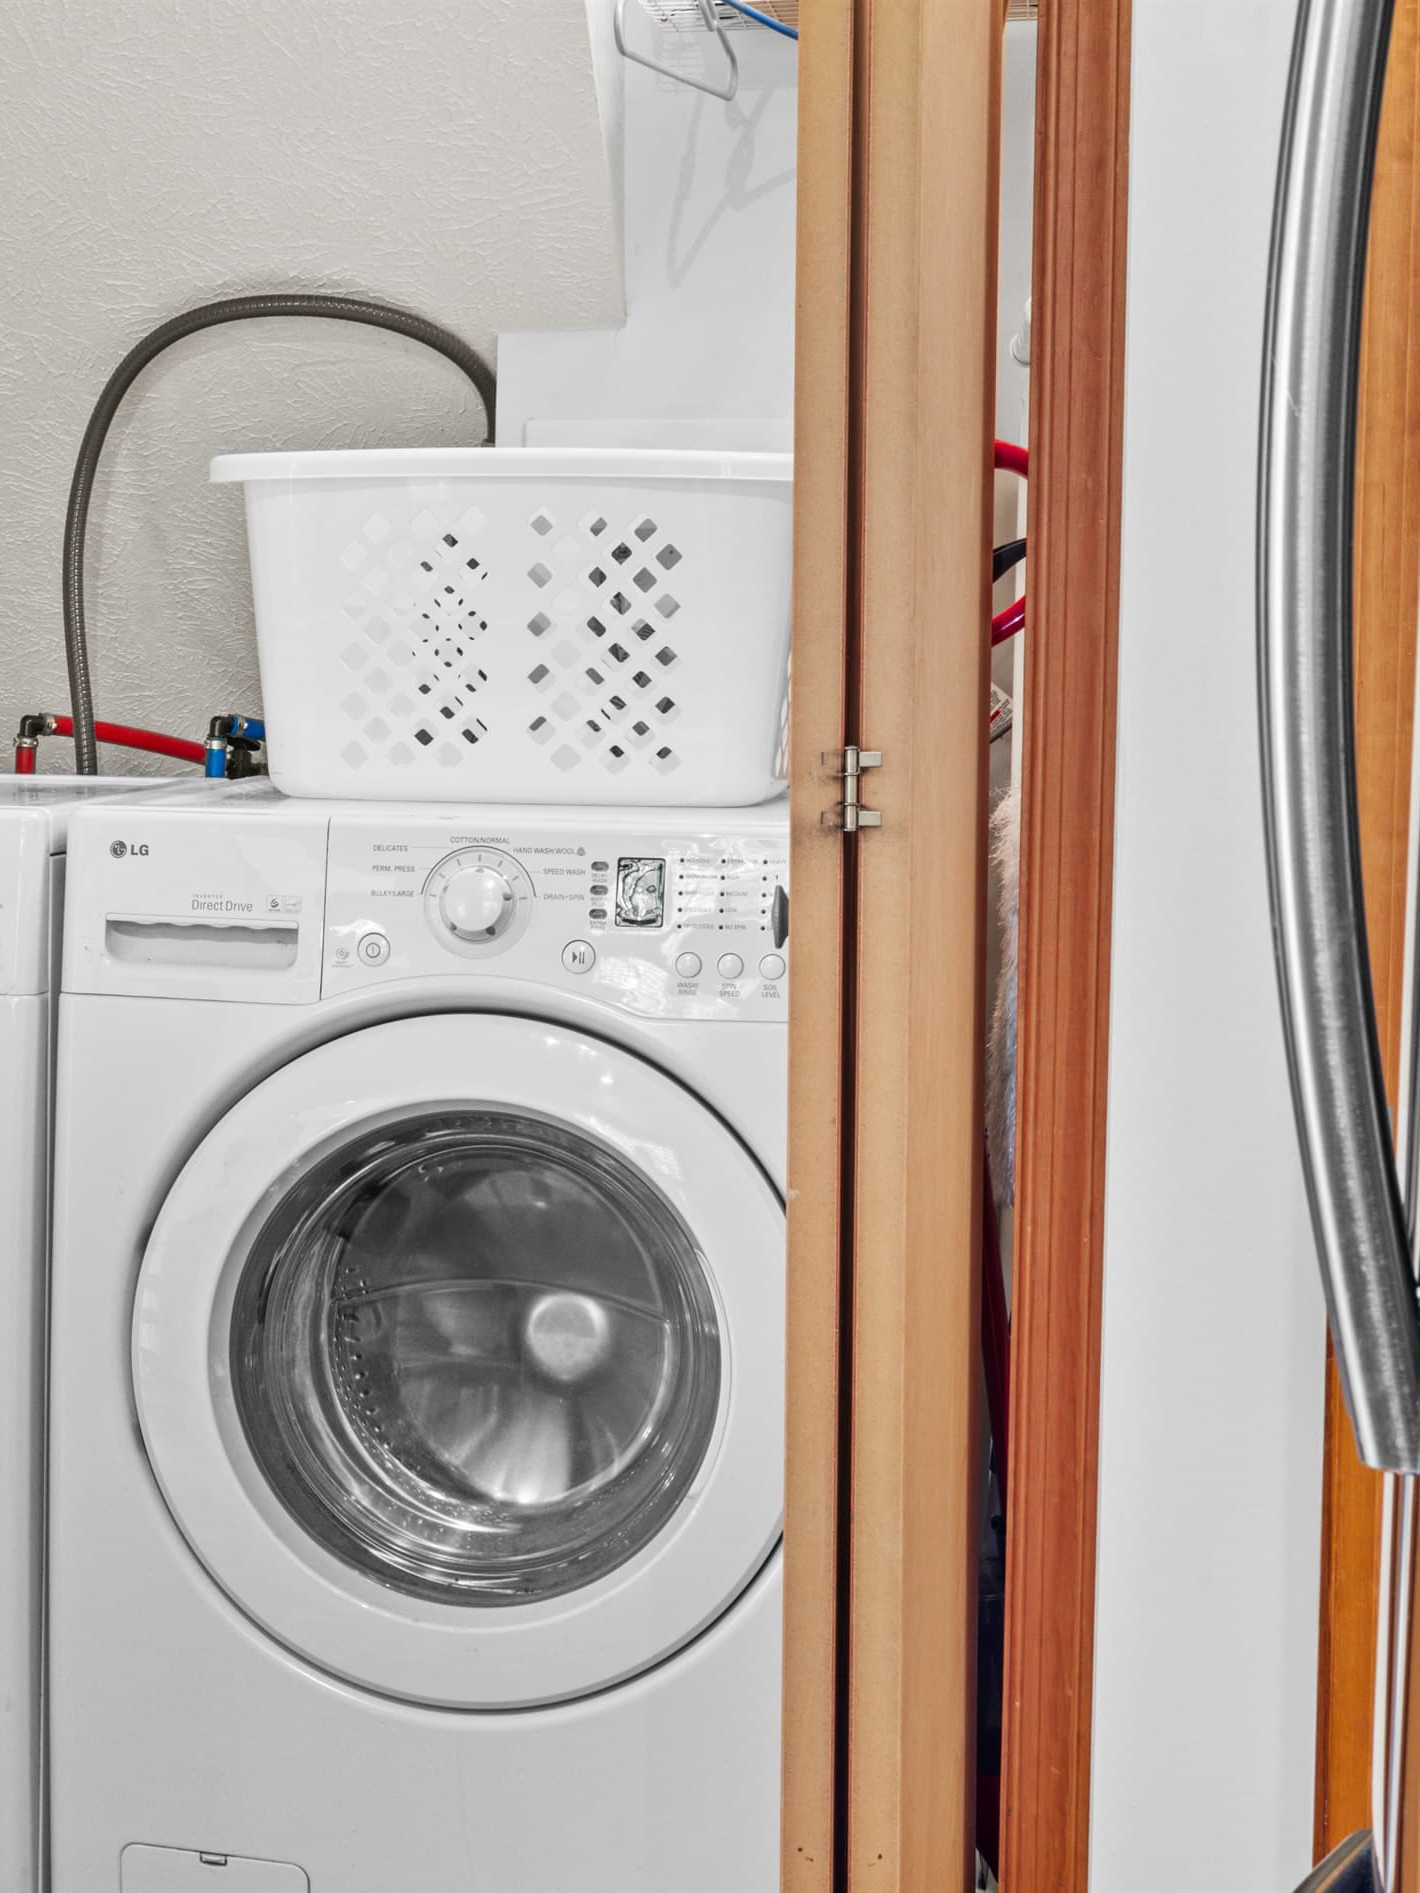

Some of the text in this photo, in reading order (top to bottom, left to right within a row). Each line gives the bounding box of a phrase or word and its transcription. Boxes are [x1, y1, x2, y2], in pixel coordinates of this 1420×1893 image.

[450, 836, 510, 844] COTTON/NORMAL
[130, 844, 149, 856] LG
[373, 844, 408, 852] DELICATES
[513, 847, 575, 855] HAND WASH/WOOL
[372, 865, 416, 873] PERM. PRESS
[371, 889, 414, 898] BULKY/LARGE
[191, 899, 253, 912] Direct Drive
[761, 991, 781, 999] LEVEL
